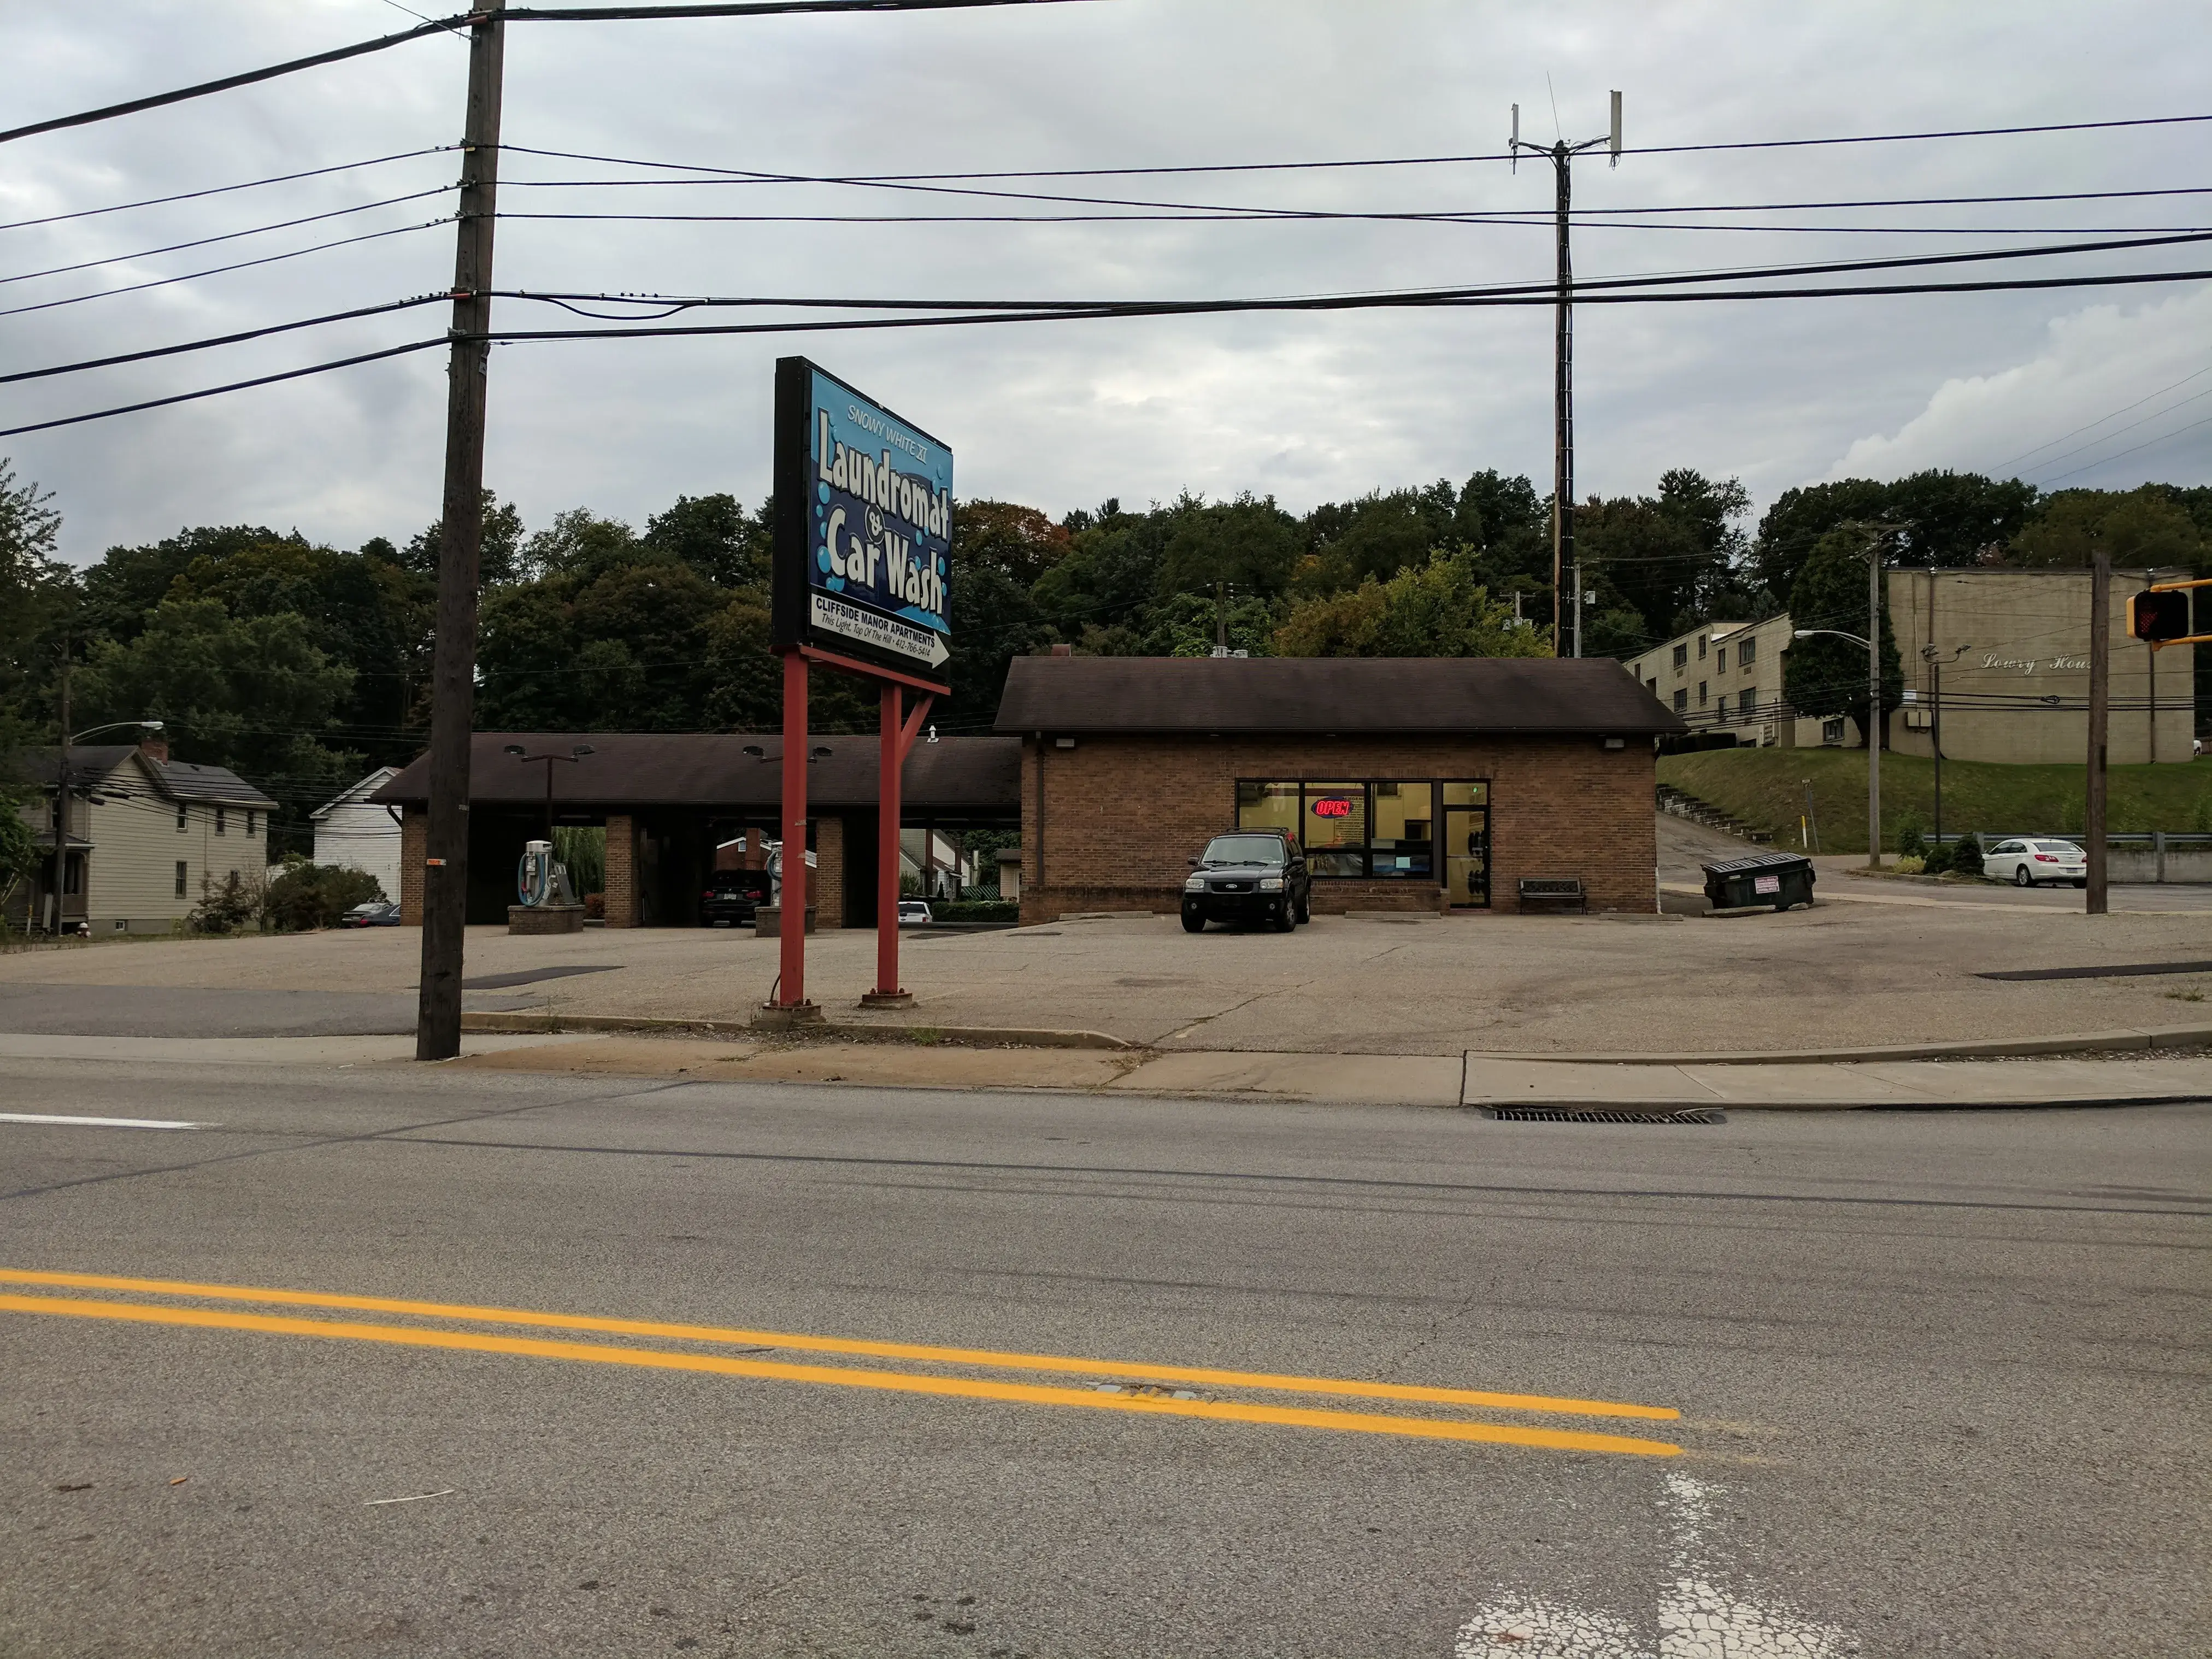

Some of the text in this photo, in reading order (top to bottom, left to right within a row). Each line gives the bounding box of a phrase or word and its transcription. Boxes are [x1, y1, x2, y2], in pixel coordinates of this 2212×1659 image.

[848, 405, 885, 438] SNOWY
[886, 426, 916, 456] WHITE
[819, 409, 949, 540] Laundromat
[869, 511, 883, 536] &
[827, 507, 943, 614] Car Wash
[816, 597, 935, 648] CLIFFSIDE MANOR APARTMENTS
[822, 613, 931, 657] This Light, Top Of The Hill 412-766-5414
[1981, 653, 2036, 676] Lowry
[1317, 801, 1349, 815] OPEN
